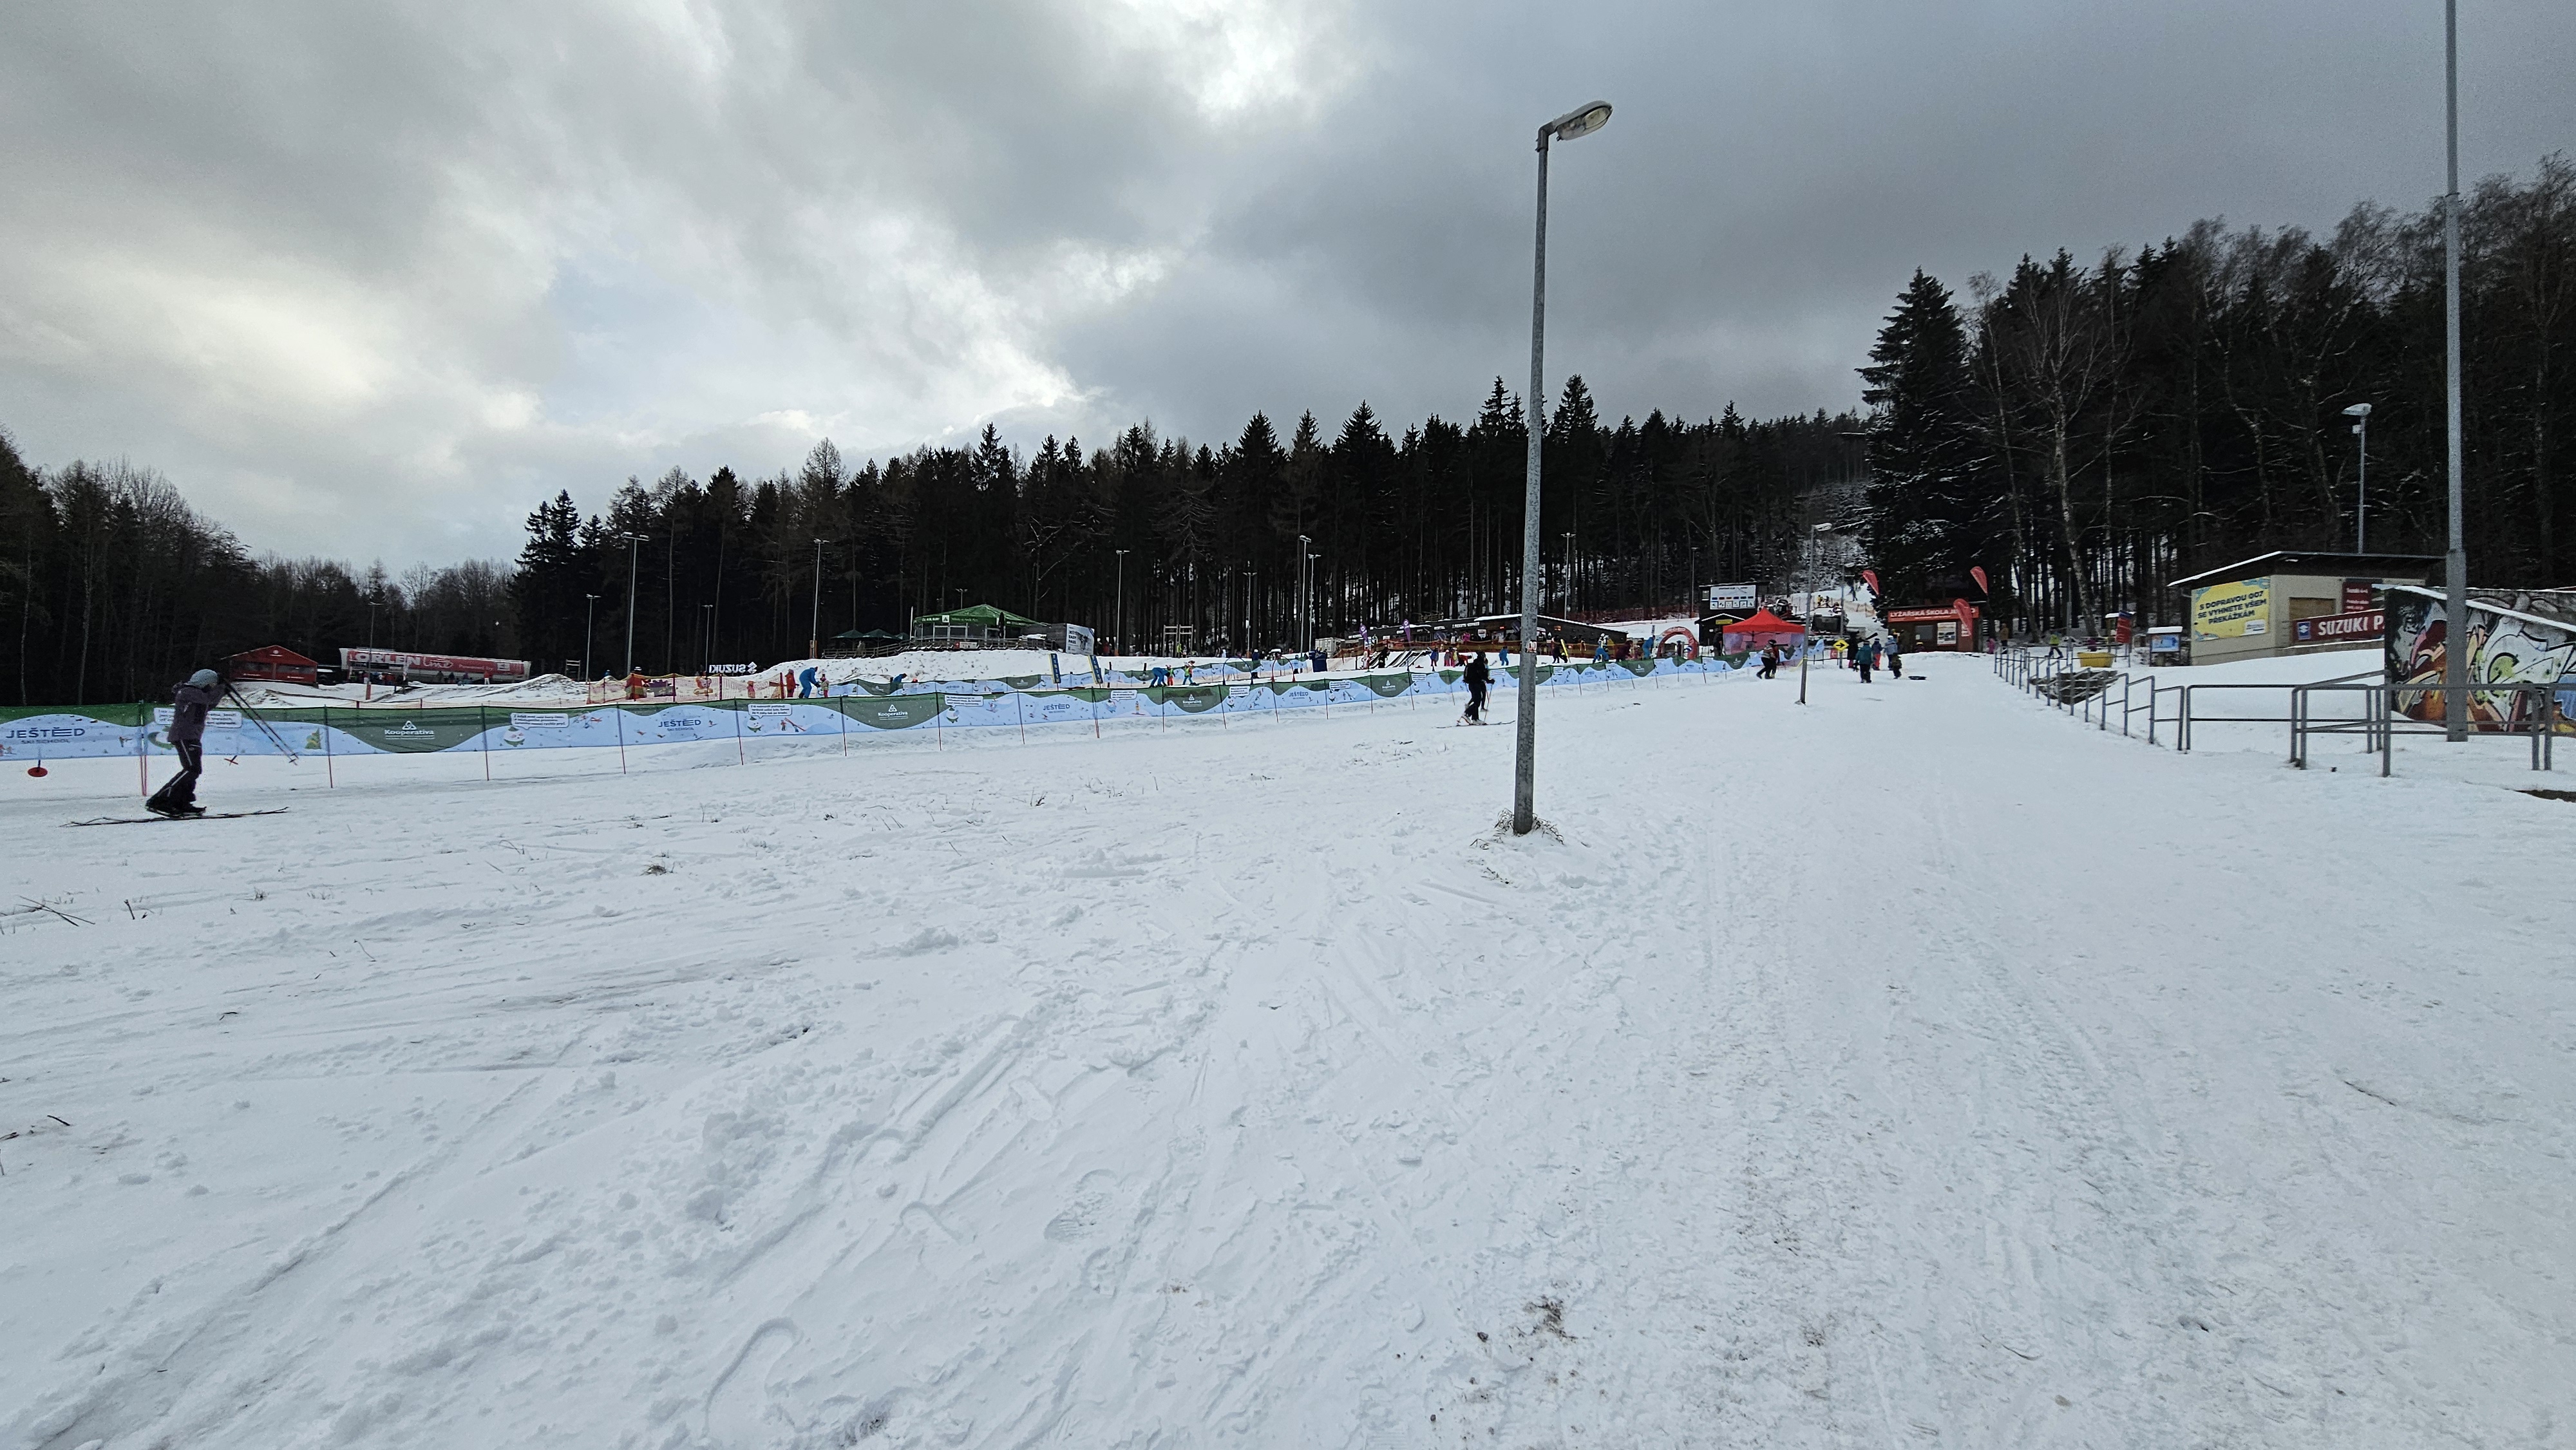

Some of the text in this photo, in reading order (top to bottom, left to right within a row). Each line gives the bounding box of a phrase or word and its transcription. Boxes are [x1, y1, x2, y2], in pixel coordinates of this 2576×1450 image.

[2206, 594, 2247, 609] DOPRAVOU
[2208, 604, 2243, 616] VYHNETE
[2245, 599, 2267, 608] VŠEM
[1889, 609, 1926, 617] LYŽAŘSKÁ
[2208, 610, 2255, 625] PŘEKÁŽKÁM
[2318, 615, 2385, 636] SUZUKI P
[355, 653, 421, 666] ORLEN
[658, 719, 701, 728] JEŠTĚD
[6, 726, 86, 739] JEŠTĚD
